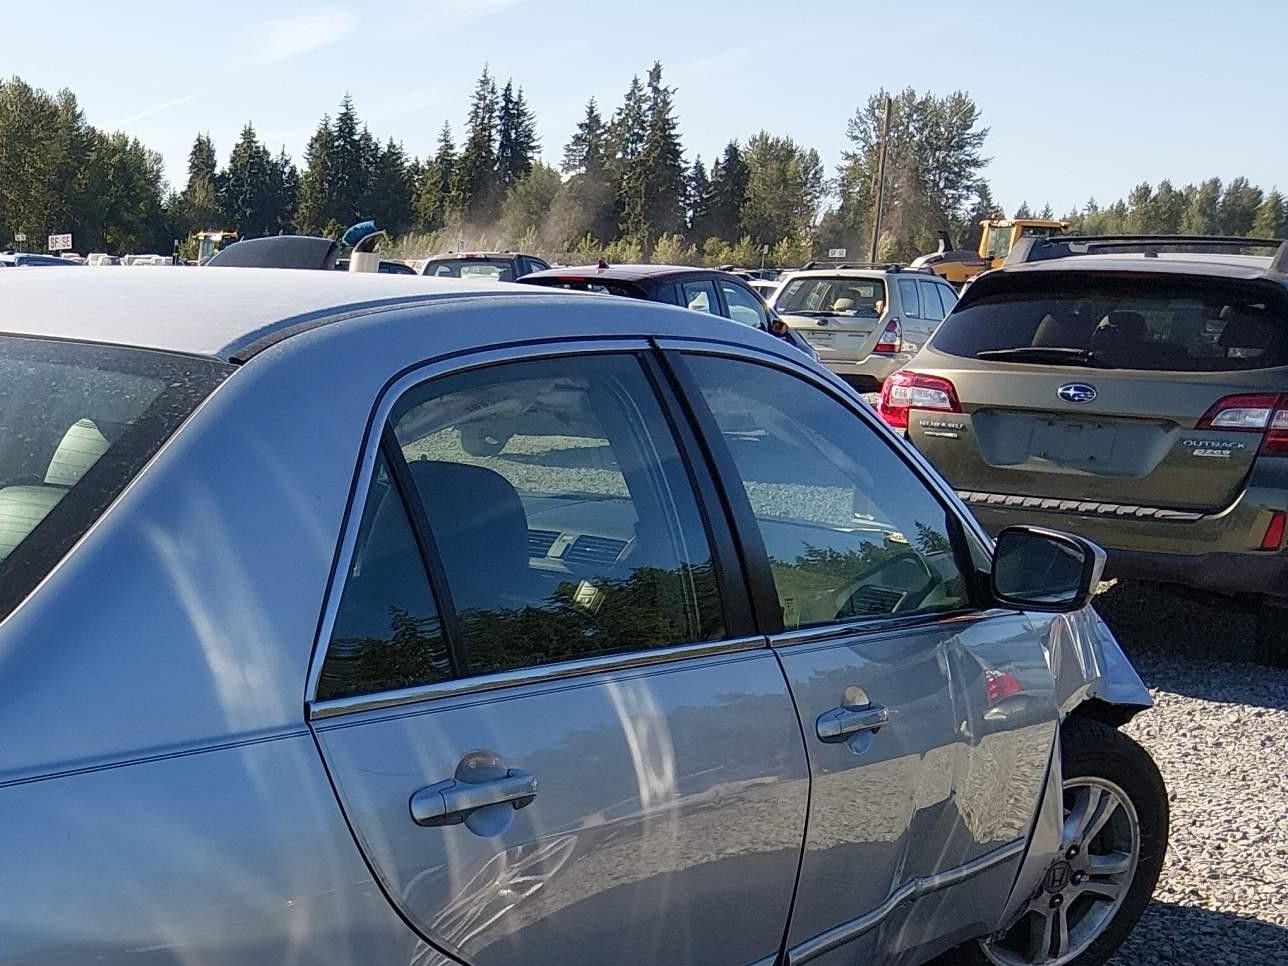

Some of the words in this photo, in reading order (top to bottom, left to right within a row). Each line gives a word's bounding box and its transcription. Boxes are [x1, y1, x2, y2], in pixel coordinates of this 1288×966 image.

[50, 237, 59, 248] SF
[61, 236, 70, 247] SE
[1183, 439, 1247, 449] OUTBACK
